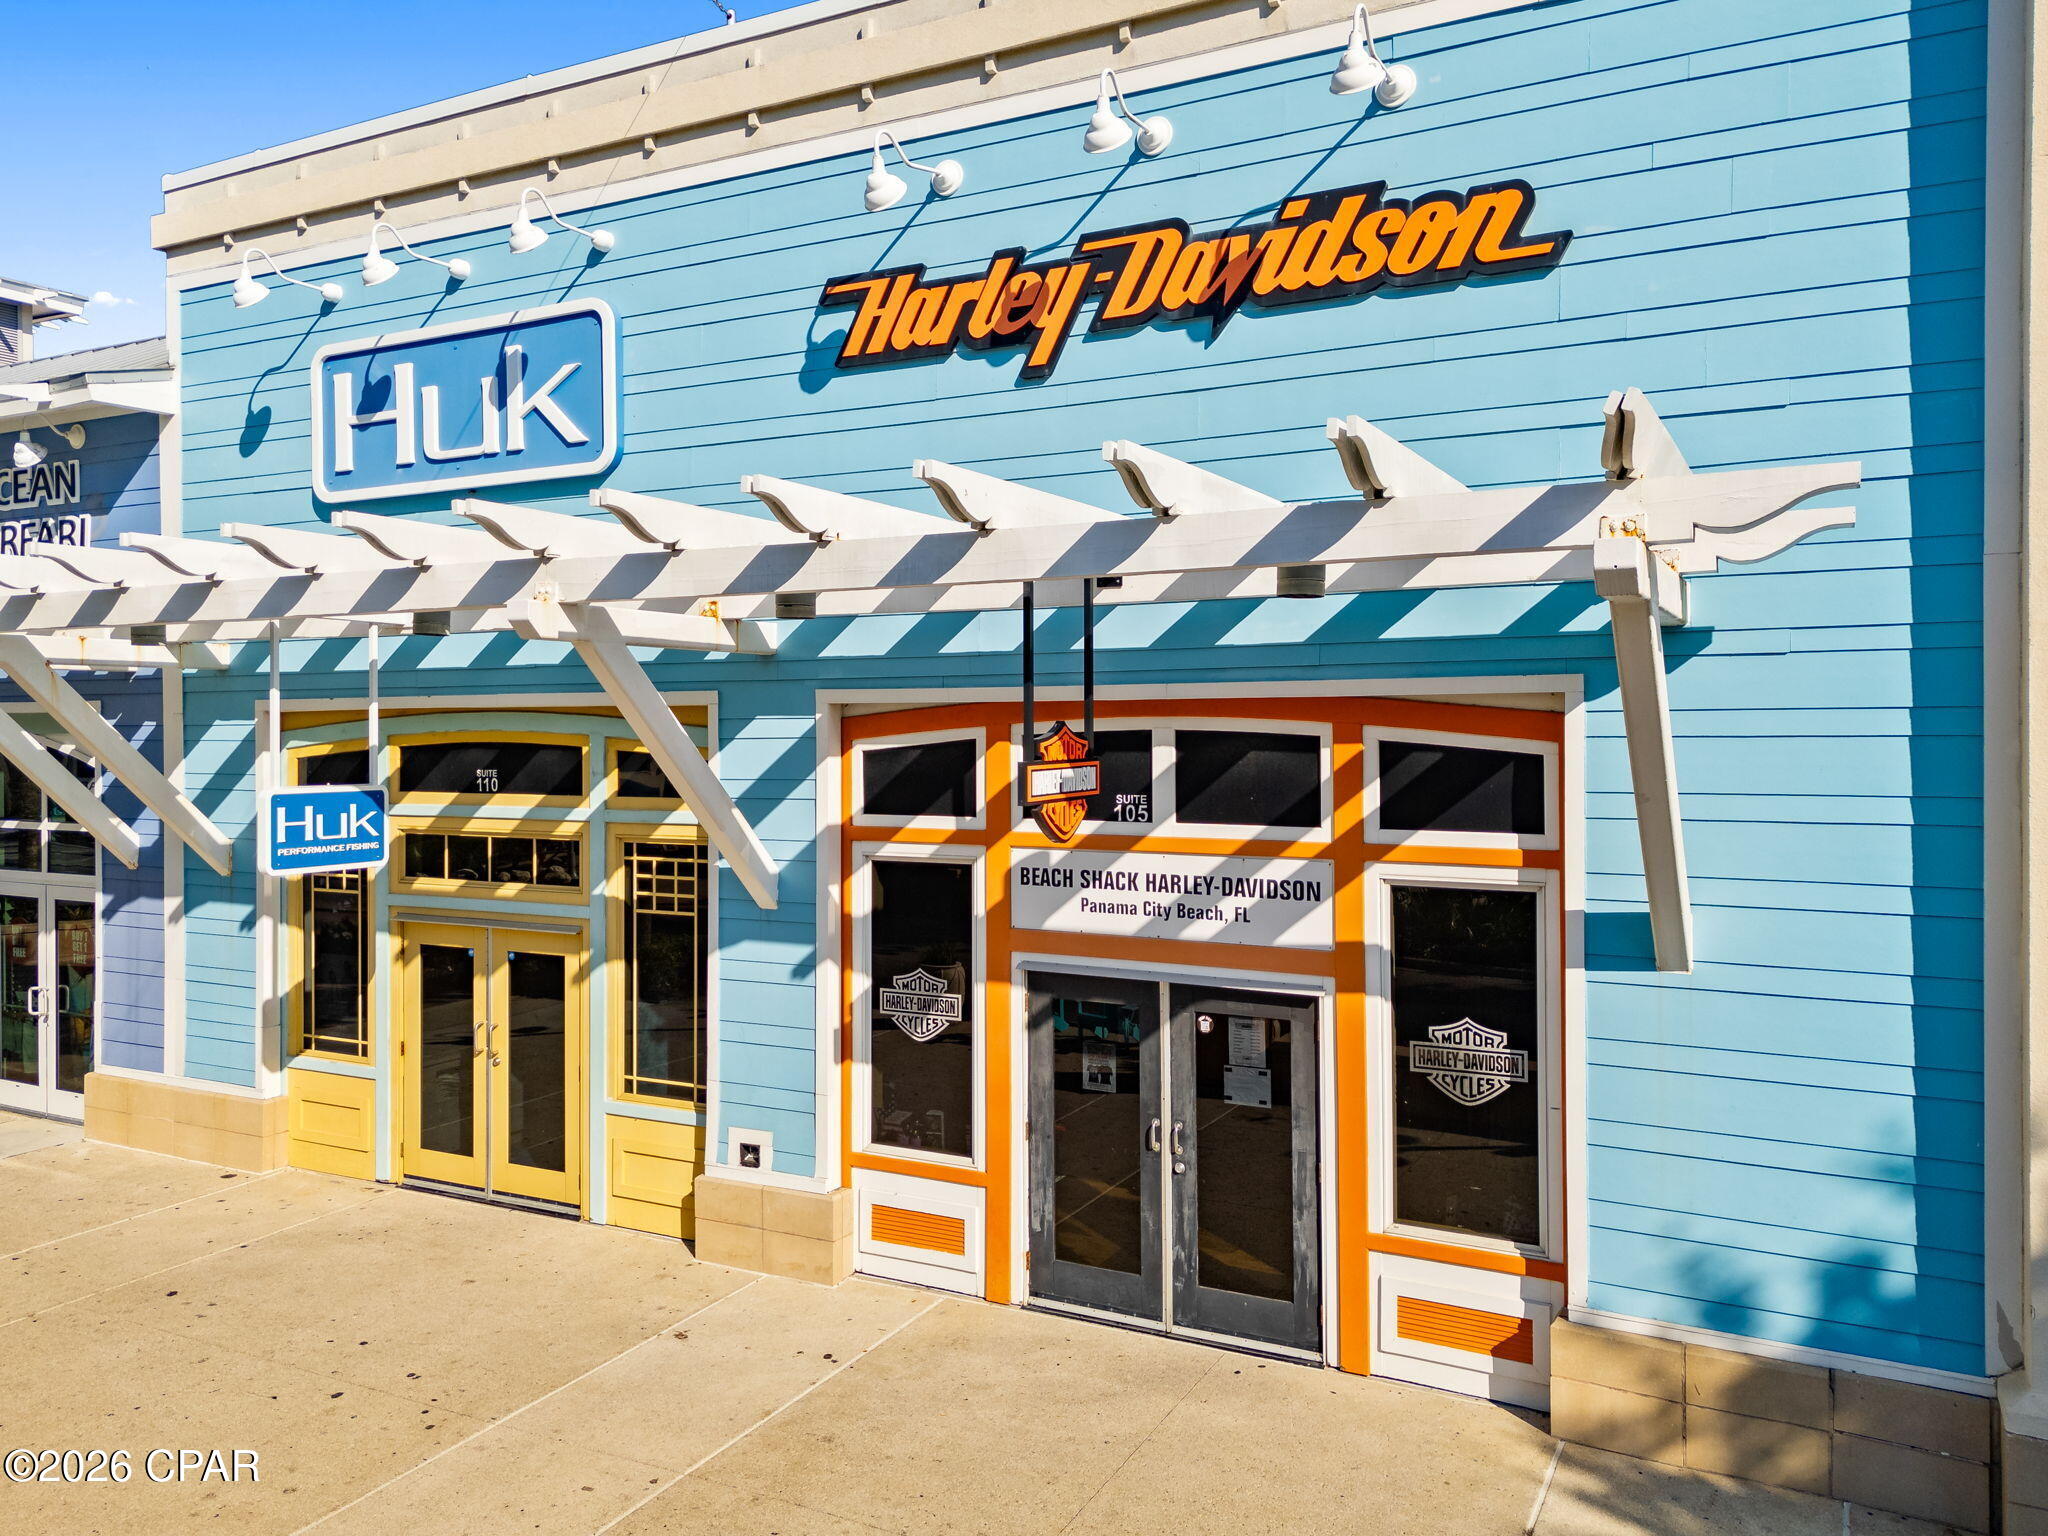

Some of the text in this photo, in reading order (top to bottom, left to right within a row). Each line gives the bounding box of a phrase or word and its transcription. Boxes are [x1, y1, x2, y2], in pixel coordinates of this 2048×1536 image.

[826, 188, 1555, 367] Harley-Davidson
[476, 769, 498, 777] SUITE
[476, 778, 499, 792] 110
[1116, 795, 1147, 804] SUITE
[1113, 804, 1148, 822] 105
[277, 842, 379, 856] PERFORMANCE FISHING
[1020, 866, 1321, 902] BEACH SHACK HARLEY-DAVIDSON
[1081, 897, 1251, 924] Panama City Beach, FL
[901, 976, 939, 994] MOTOR
[885, 994, 956, 1015] HARLEY-DAVIDSON
[902, 1014, 939, 1035] CYCLES
[1441, 1027, 1495, 1049] MOTOR
[1418, 1049, 1520, 1075] HARLEY-DAVIDSON
[1441, 1073, 1495, 1098] CYCLES
